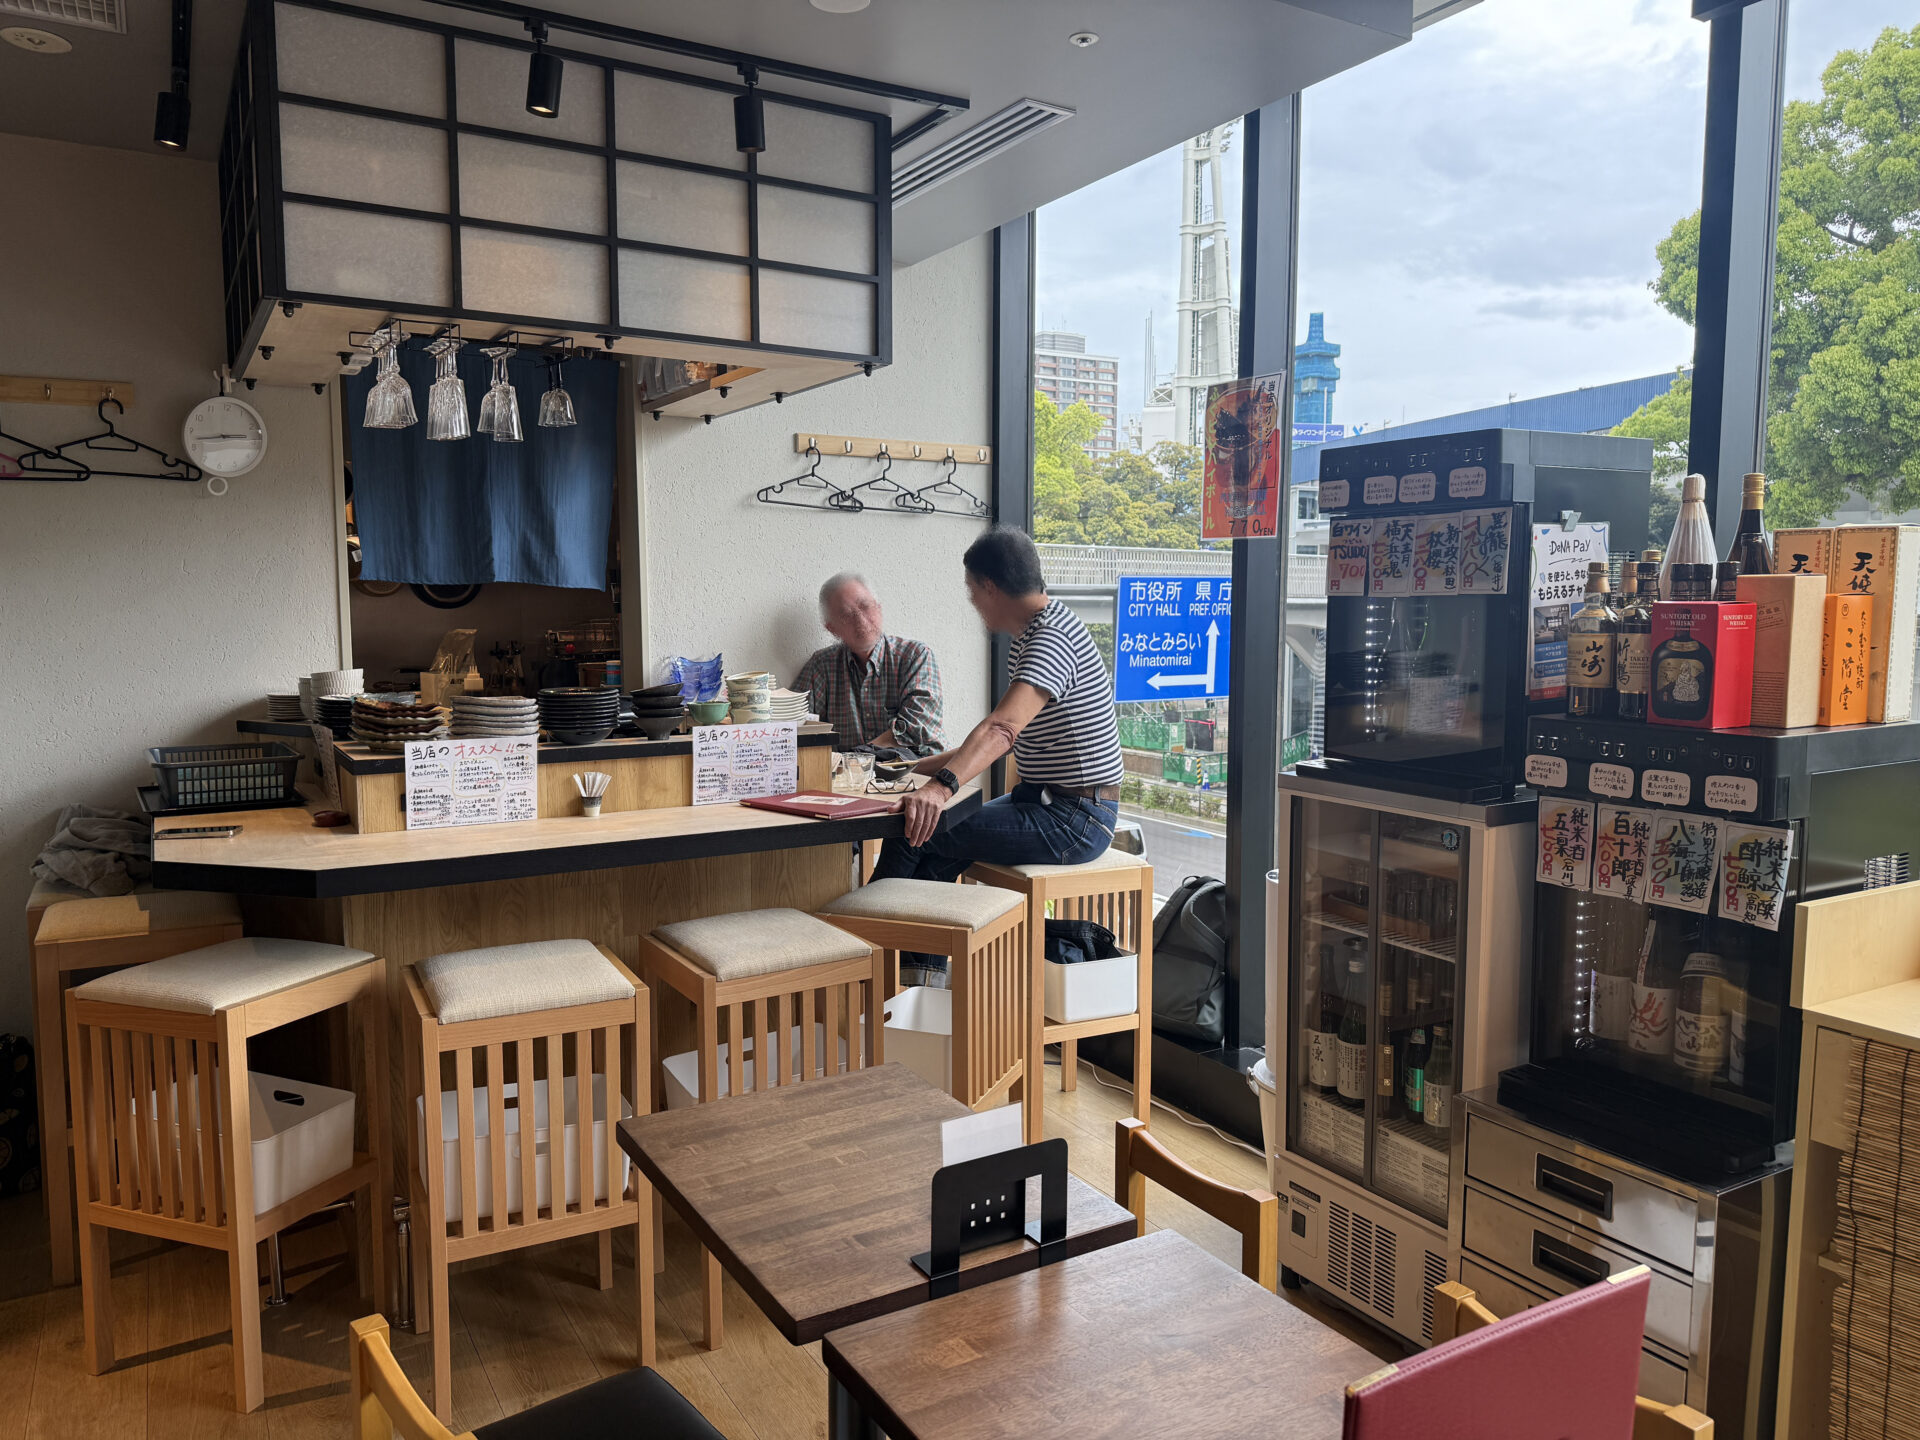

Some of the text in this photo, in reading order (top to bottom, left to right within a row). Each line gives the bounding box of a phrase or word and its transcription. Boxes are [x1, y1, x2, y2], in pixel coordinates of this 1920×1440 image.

[1259, 527, 1274, 536] YEN
[1332, 521, 1371, 538] 白ワイン
[1129, 581, 1183, 602] 市役所
[1330, 579, 1341, 591] 円
[1538, 584, 1587, 600] もらえるチャ
[1128, 603, 1153, 617] CITY
[1155, 603, 1182, 616] HALL
[1120, 632, 1201, 652] みなとみらい
[1129, 653, 1192, 668] Minatomirai
[698, 729, 729, 743] 当店の
[411, 745, 450, 761] 当店の
[1570, 808, 1588, 860] 純米酒
[1611, 811, 1631, 882] 百十郎
[1630, 820, 1650, 876] 純米酒
